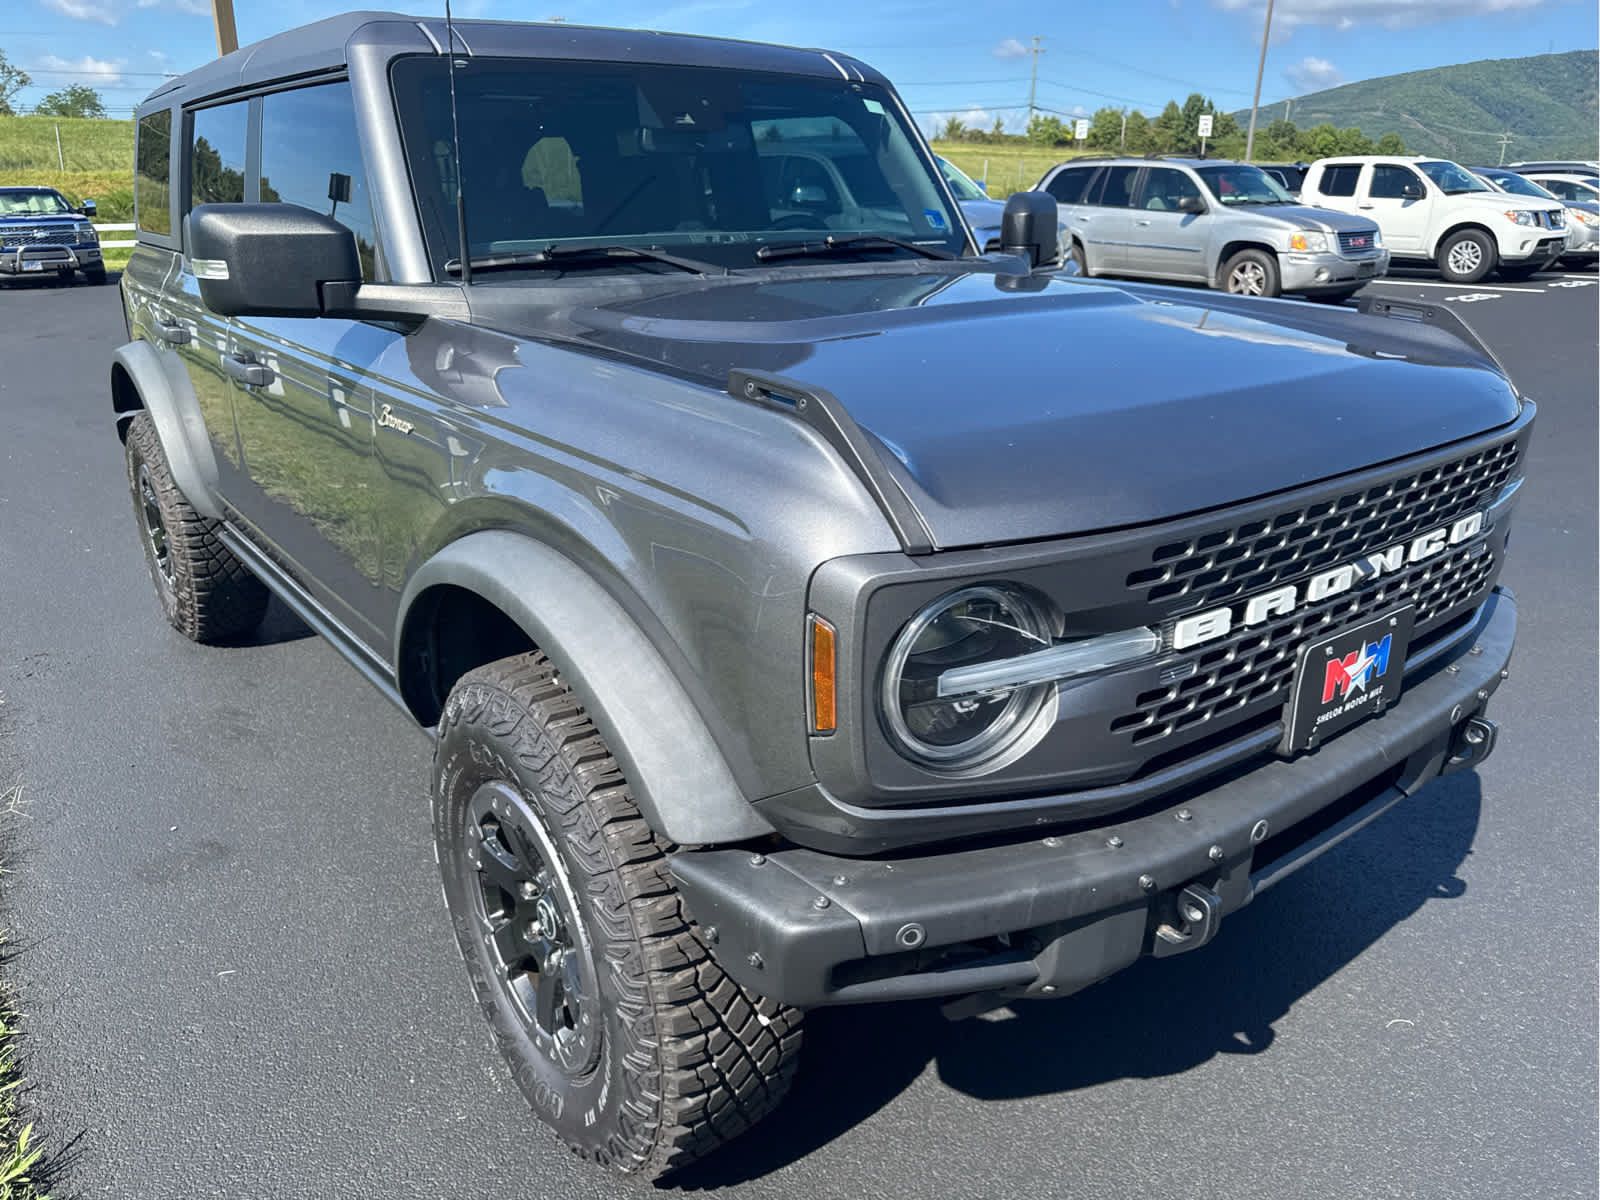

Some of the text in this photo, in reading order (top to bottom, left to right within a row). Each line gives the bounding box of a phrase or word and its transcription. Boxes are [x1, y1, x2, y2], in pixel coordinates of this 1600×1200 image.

[1173, 511, 1483, 650] BRONCO
[1316, 705, 1343, 724] SHELOR
[1343, 693, 1368, 712] MOTOR
